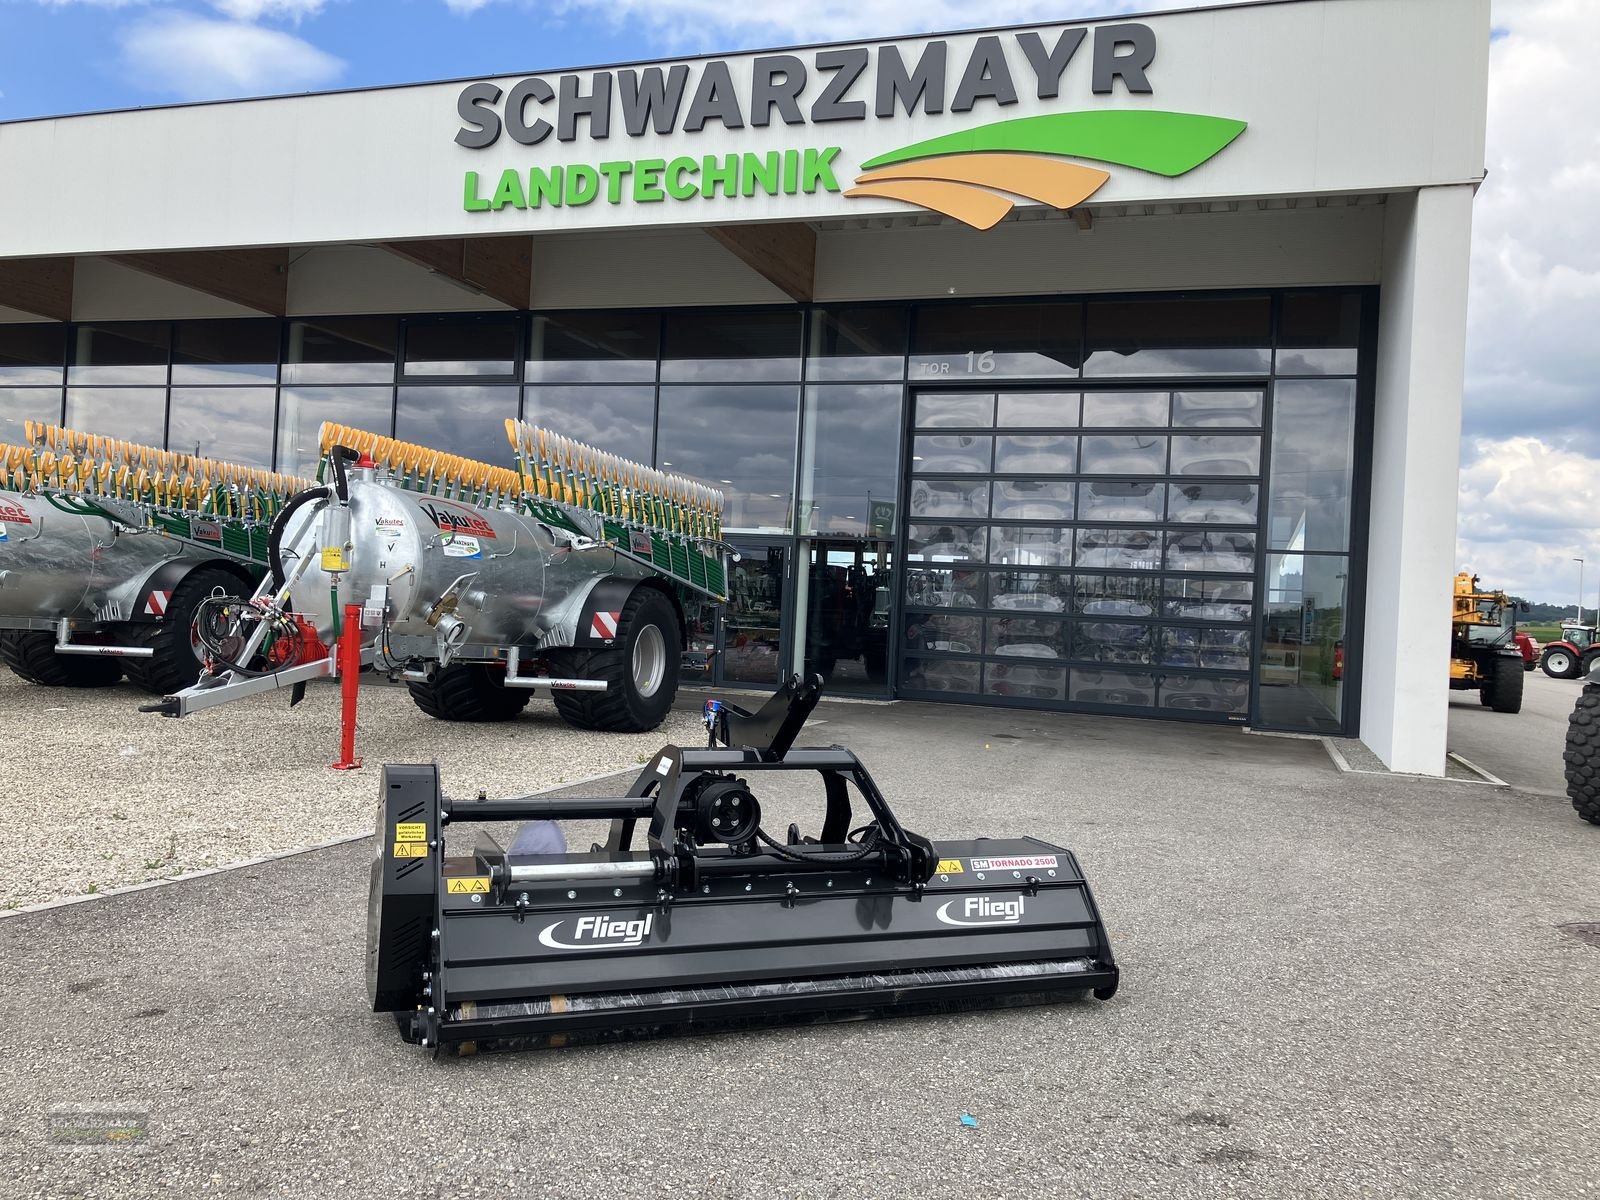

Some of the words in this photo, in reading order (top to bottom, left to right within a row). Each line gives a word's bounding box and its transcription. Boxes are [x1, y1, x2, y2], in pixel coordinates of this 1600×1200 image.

[454, 23, 1156, 149] SCHWARZMAYR
[464, 147, 841, 212] LANDTECHNIK
[920, 363, 950, 374] TOR
[966, 350, 995, 373] 16
[375, 516, 404, 526] Vakutec
[418, 503, 494, 532] Vakutec
[973, 860, 990, 869] SM
[990, 859, 1032, 867] TORNADO
[964, 896, 1024, 919] Fliegl
[574, 914, 653, 942] Fliegl
